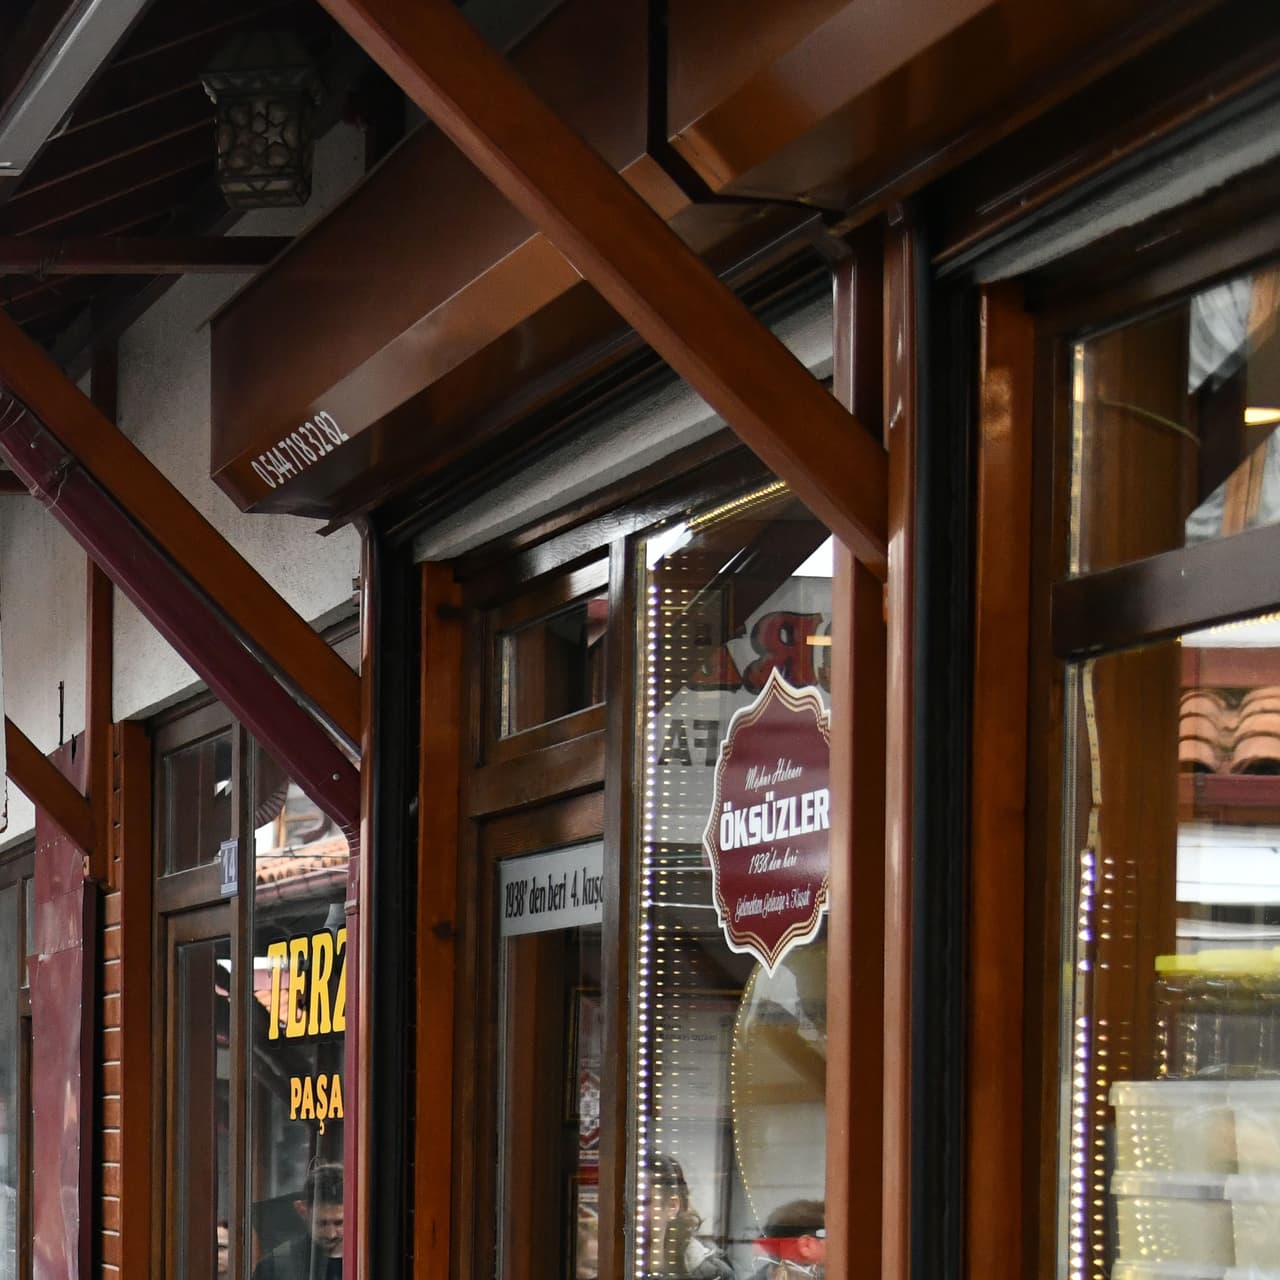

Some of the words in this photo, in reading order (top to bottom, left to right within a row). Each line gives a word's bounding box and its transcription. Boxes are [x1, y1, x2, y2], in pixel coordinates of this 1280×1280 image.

[720, 788, 830, 851] ÖKSÜZLER
[529, 876, 545, 914] den
[548, 872, 566, 911] beri
[267, 928, 346, 1041] TERZ
[290, 1074, 344, 1136] PAŞA
